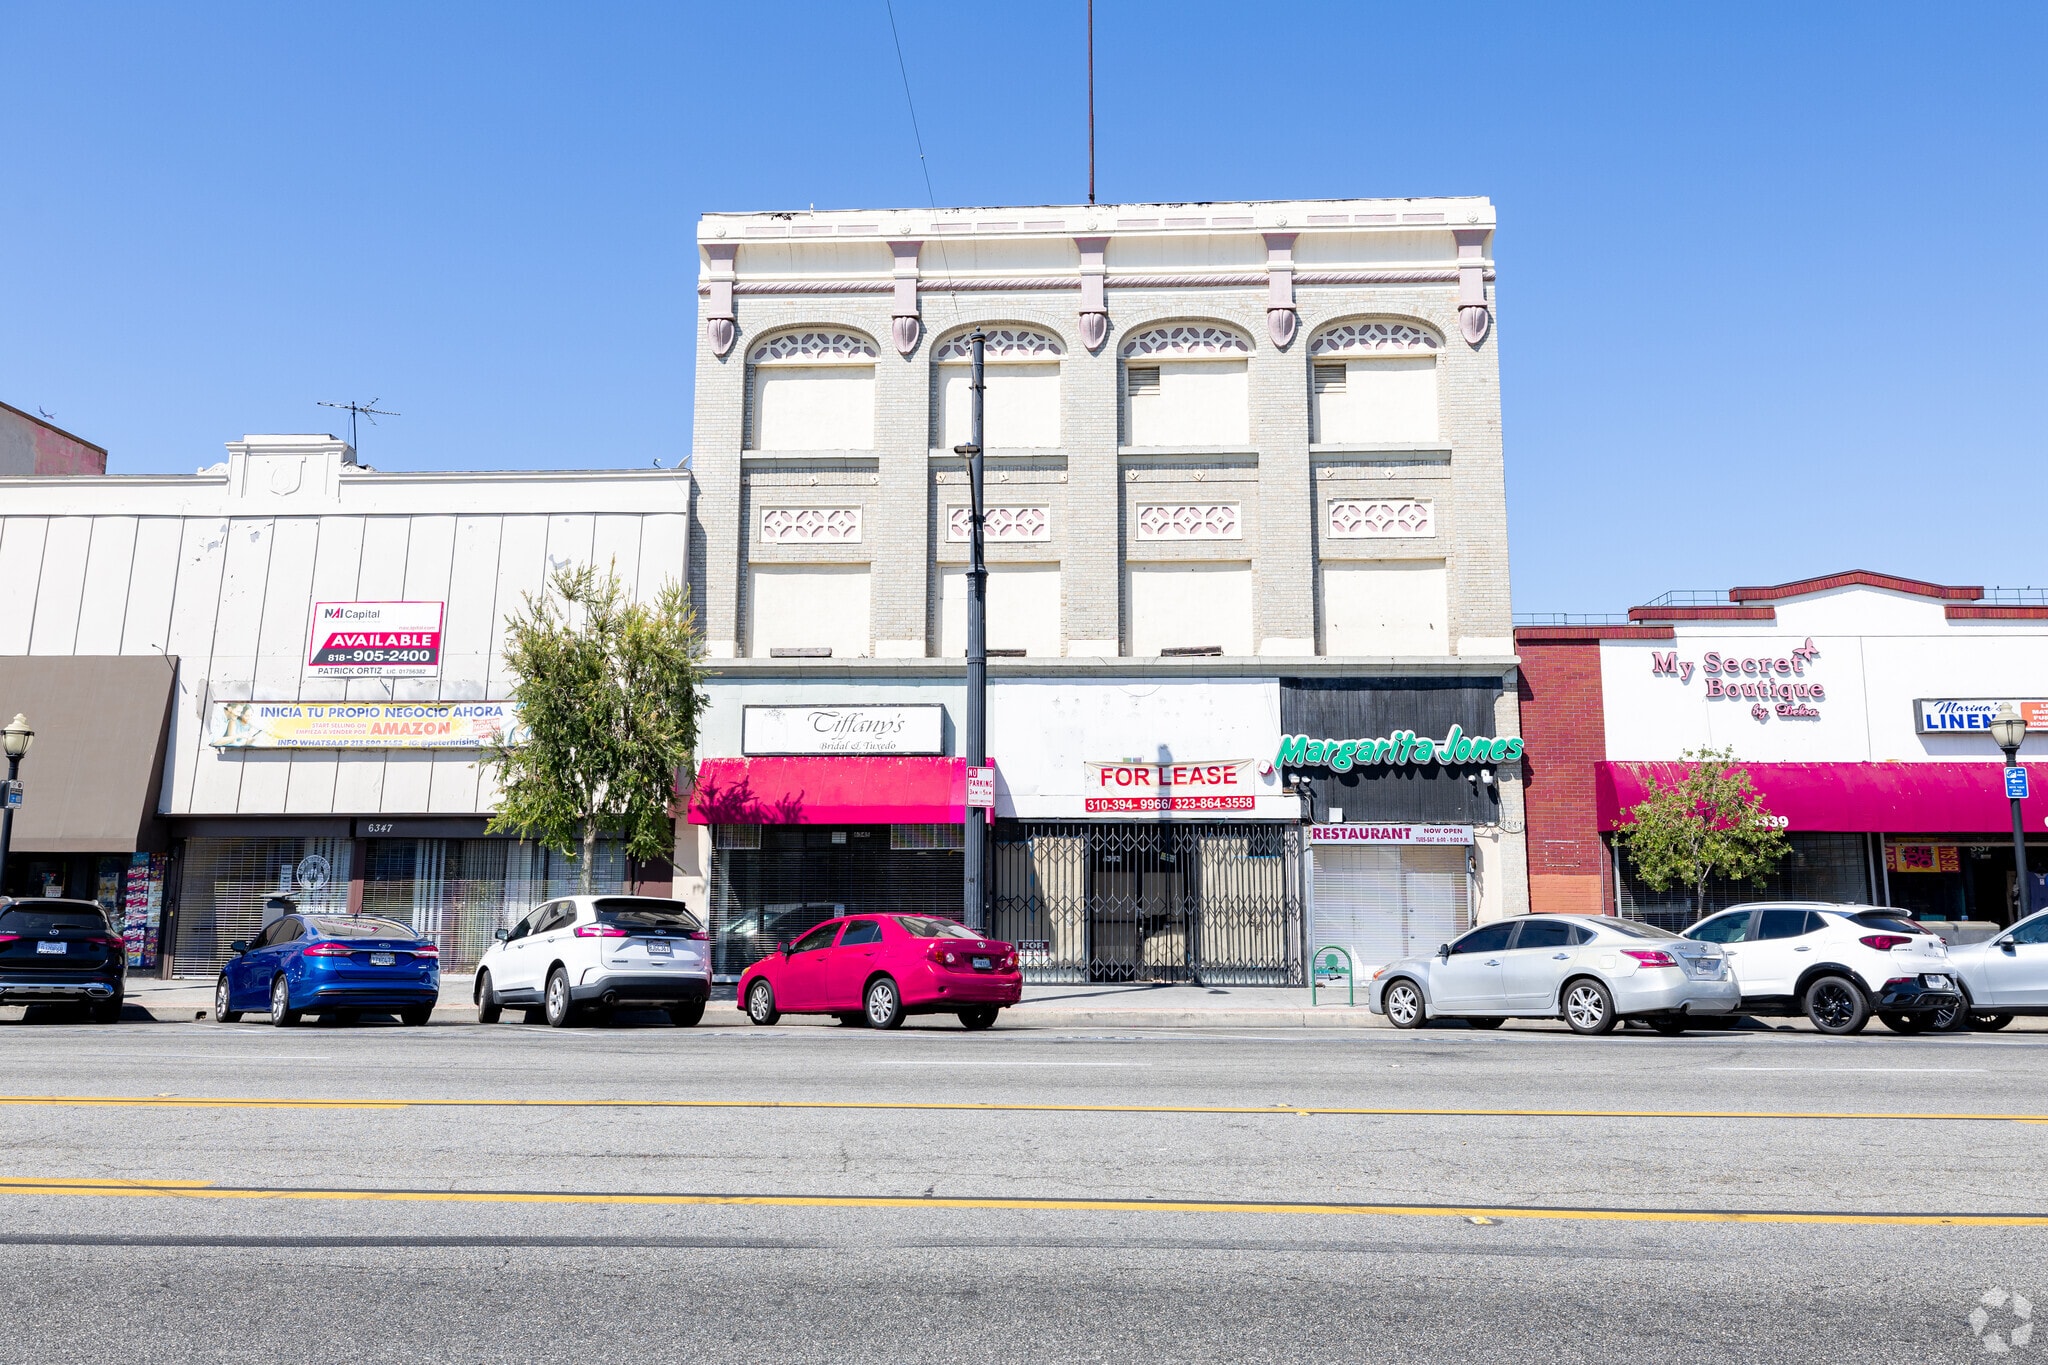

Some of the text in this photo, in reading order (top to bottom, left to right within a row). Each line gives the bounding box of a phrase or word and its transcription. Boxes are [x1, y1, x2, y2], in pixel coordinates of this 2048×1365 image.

[324, 608, 380, 620] NAI Capital
[331, 634, 432, 646] AVAILABLE
[328, 650, 430, 662] 818-905-2400
[1652, 652, 1804, 680] My Secret
[1705, 678, 1824, 702] Boutique
[260, 706, 503, 718] INICIA TU PROPIO NEGOCIO AHORA
[1752, 703, 1769, 720] by
[1934, 700, 2002, 713] Marina's
[370, 722, 451, 735] AMAZON
[807, 711, 905, 740] Tiffany's
[819, 741, 896, 751] Bridal & Tuxedo
[1275, 724, 1524, 772] Margarita Jones
[969, 769, 977, 777] NO
[1101, 766, 1238, 786] FOR LEASE
[1087, 798, 1253, 810] 310-394- 9966/ 323-864-3558
[368, 824, 393, 832] 6347
[1755, 815, 1789, 828] 339
[1312, 827, 1412, 840] RESTAURANT
